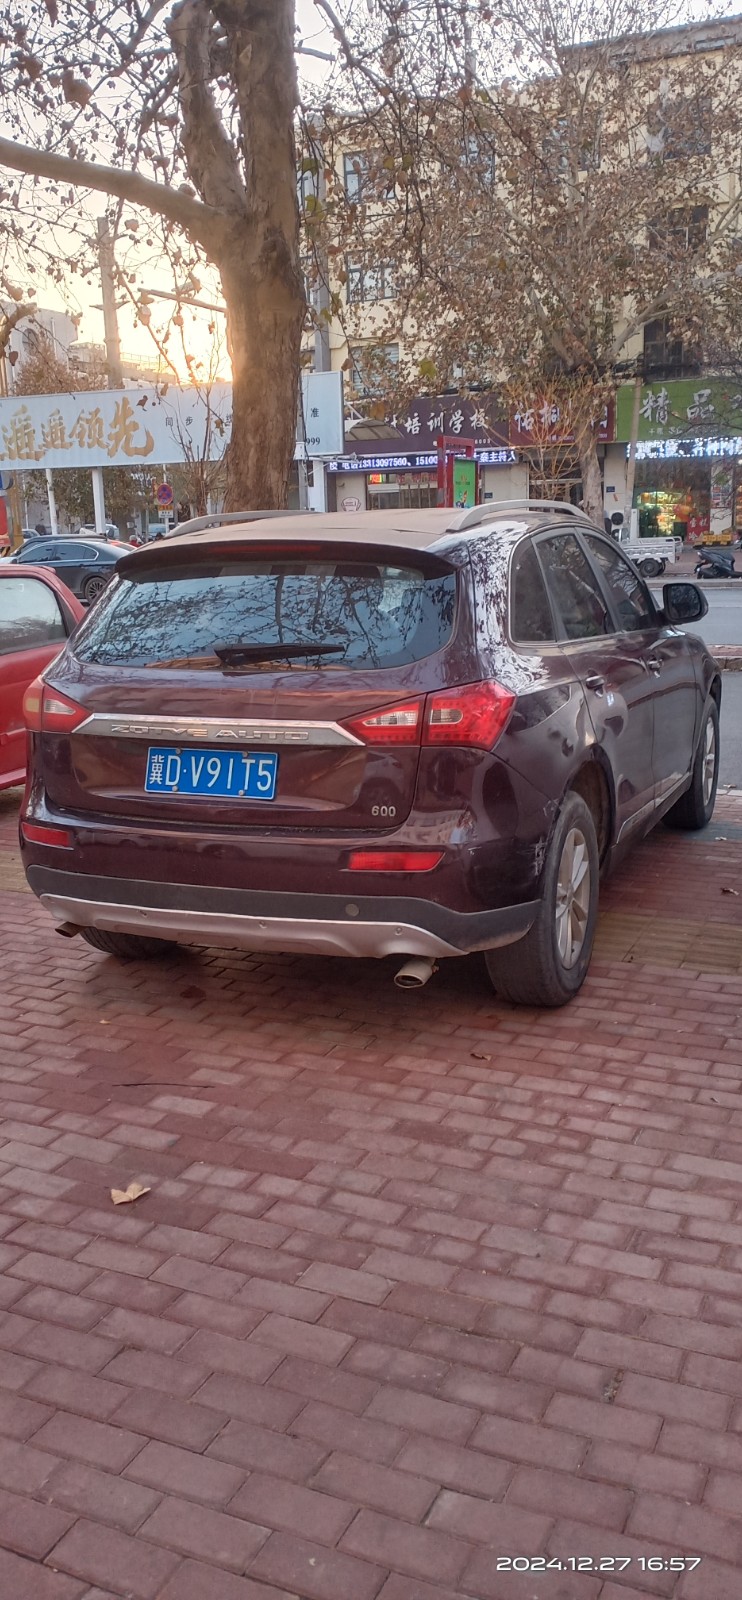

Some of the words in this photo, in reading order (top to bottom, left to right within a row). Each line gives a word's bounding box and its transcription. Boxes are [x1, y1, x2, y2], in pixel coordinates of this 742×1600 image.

[111, 724, 208, 737] ZOTYE
[215, 729, 309, 740] AUTO
[371, 805, 396, 817] 600
